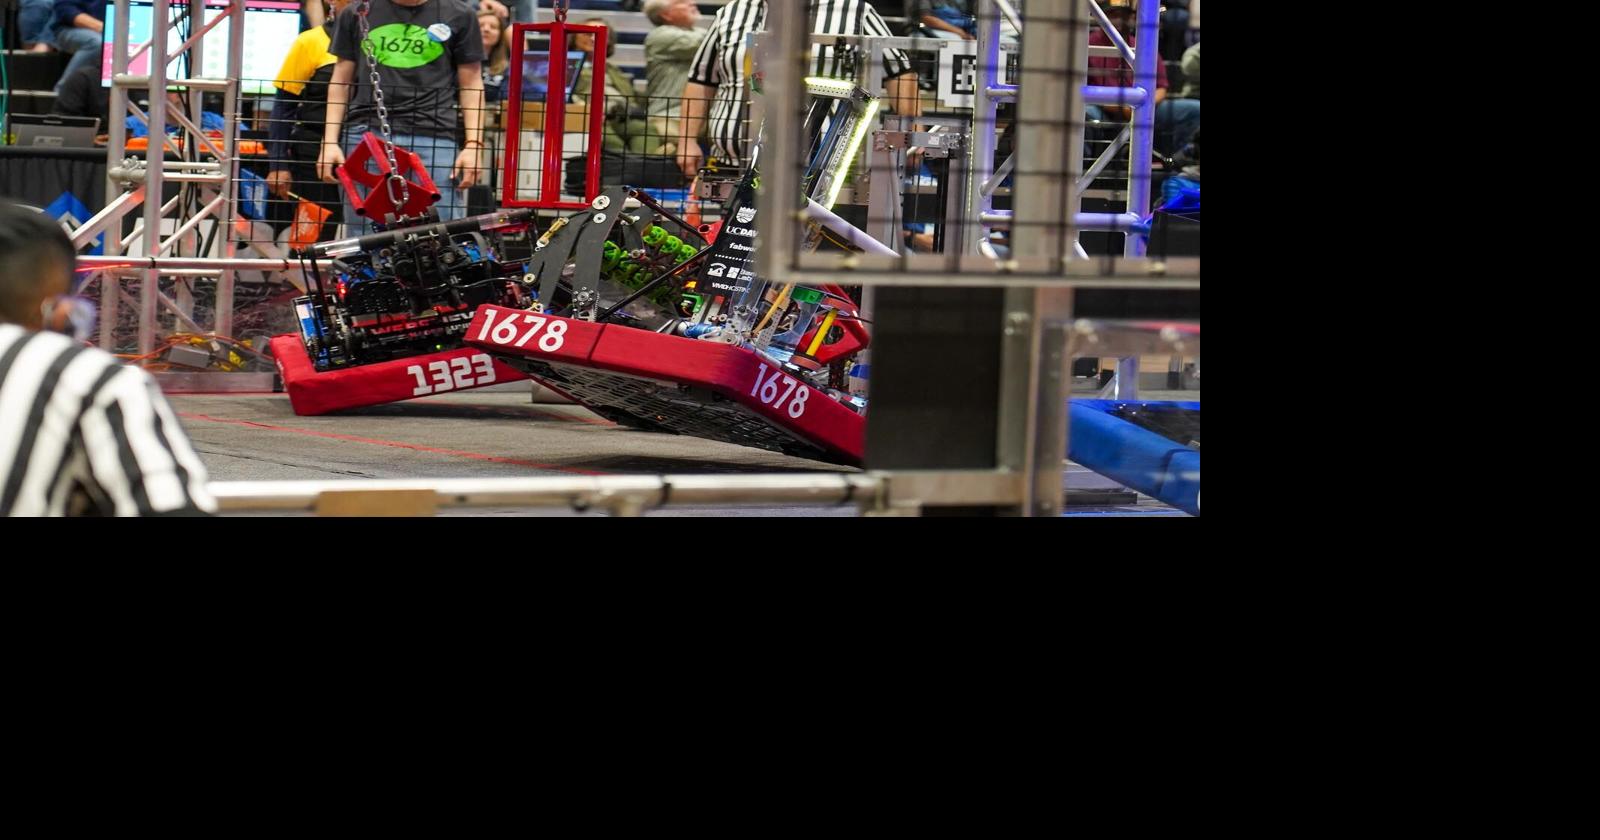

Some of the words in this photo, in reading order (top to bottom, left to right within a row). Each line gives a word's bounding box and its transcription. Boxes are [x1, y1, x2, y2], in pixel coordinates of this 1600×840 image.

[379, 36, 424, 55] 1678
[477, 308, 568, 353] 1678
[407, 353, 496, 396] 1323
[750, 363, 810, 418] 1678
